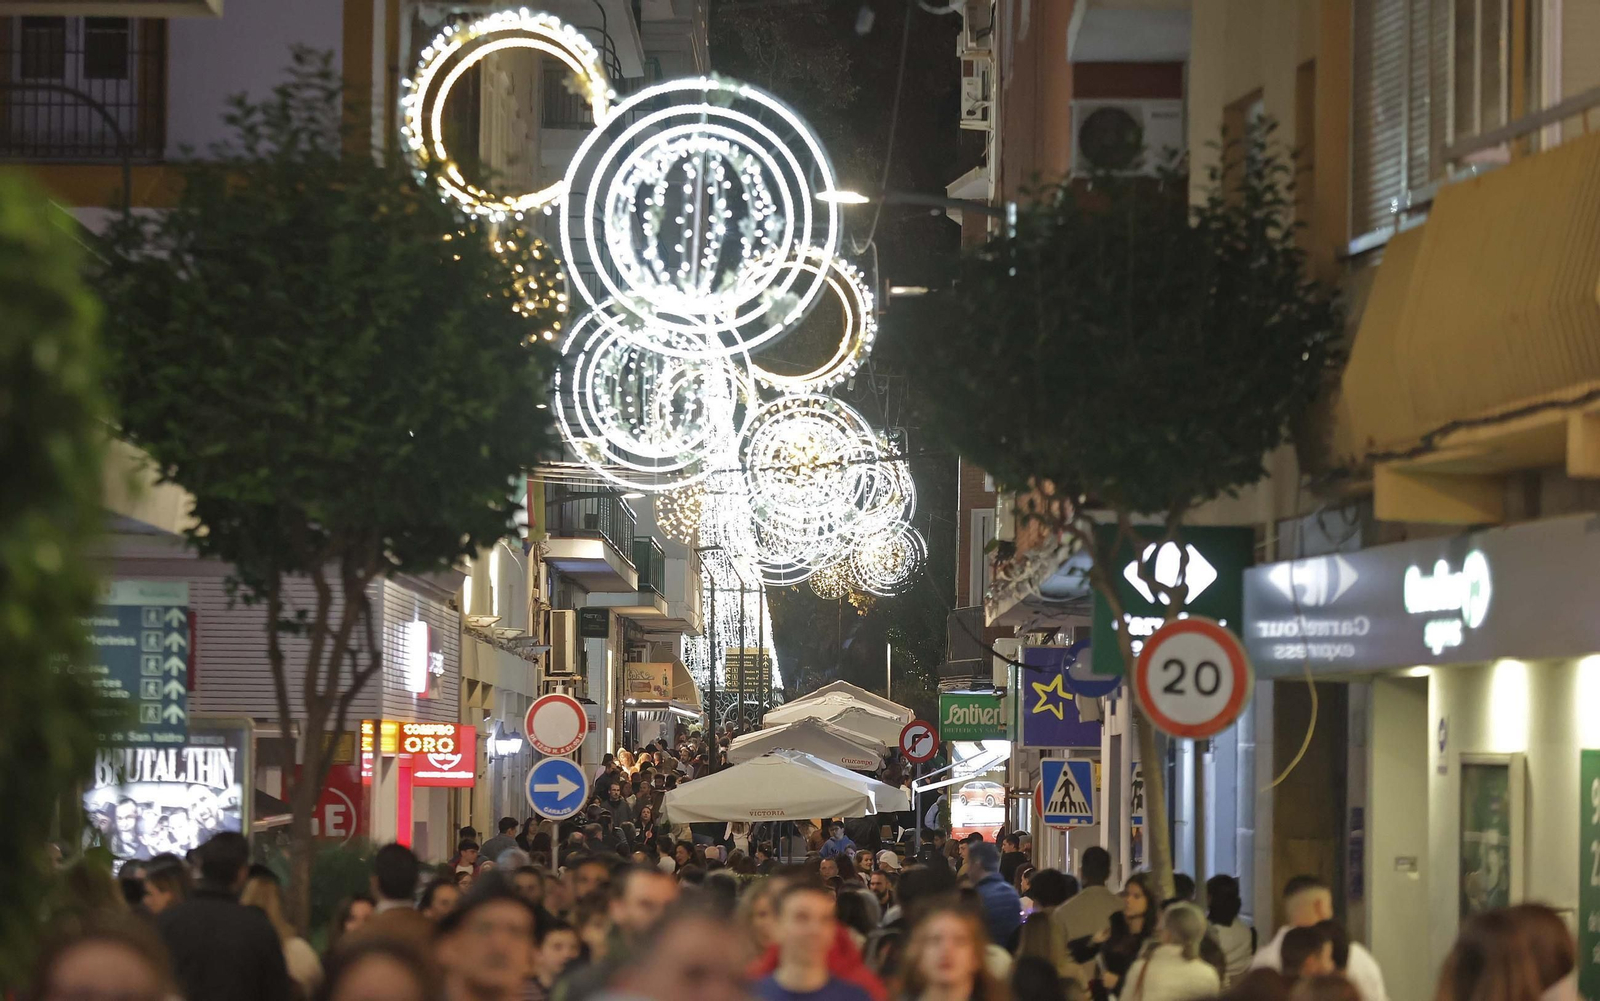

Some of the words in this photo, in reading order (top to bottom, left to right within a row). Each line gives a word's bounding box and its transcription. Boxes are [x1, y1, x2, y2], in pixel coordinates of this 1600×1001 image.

[1162, 658, 1221, 696] 20
[404, 736, 454, 753] ORO
[841, 757, 873, 766] Cruzcampo
[543, 806, 572, 815] GARAJES
